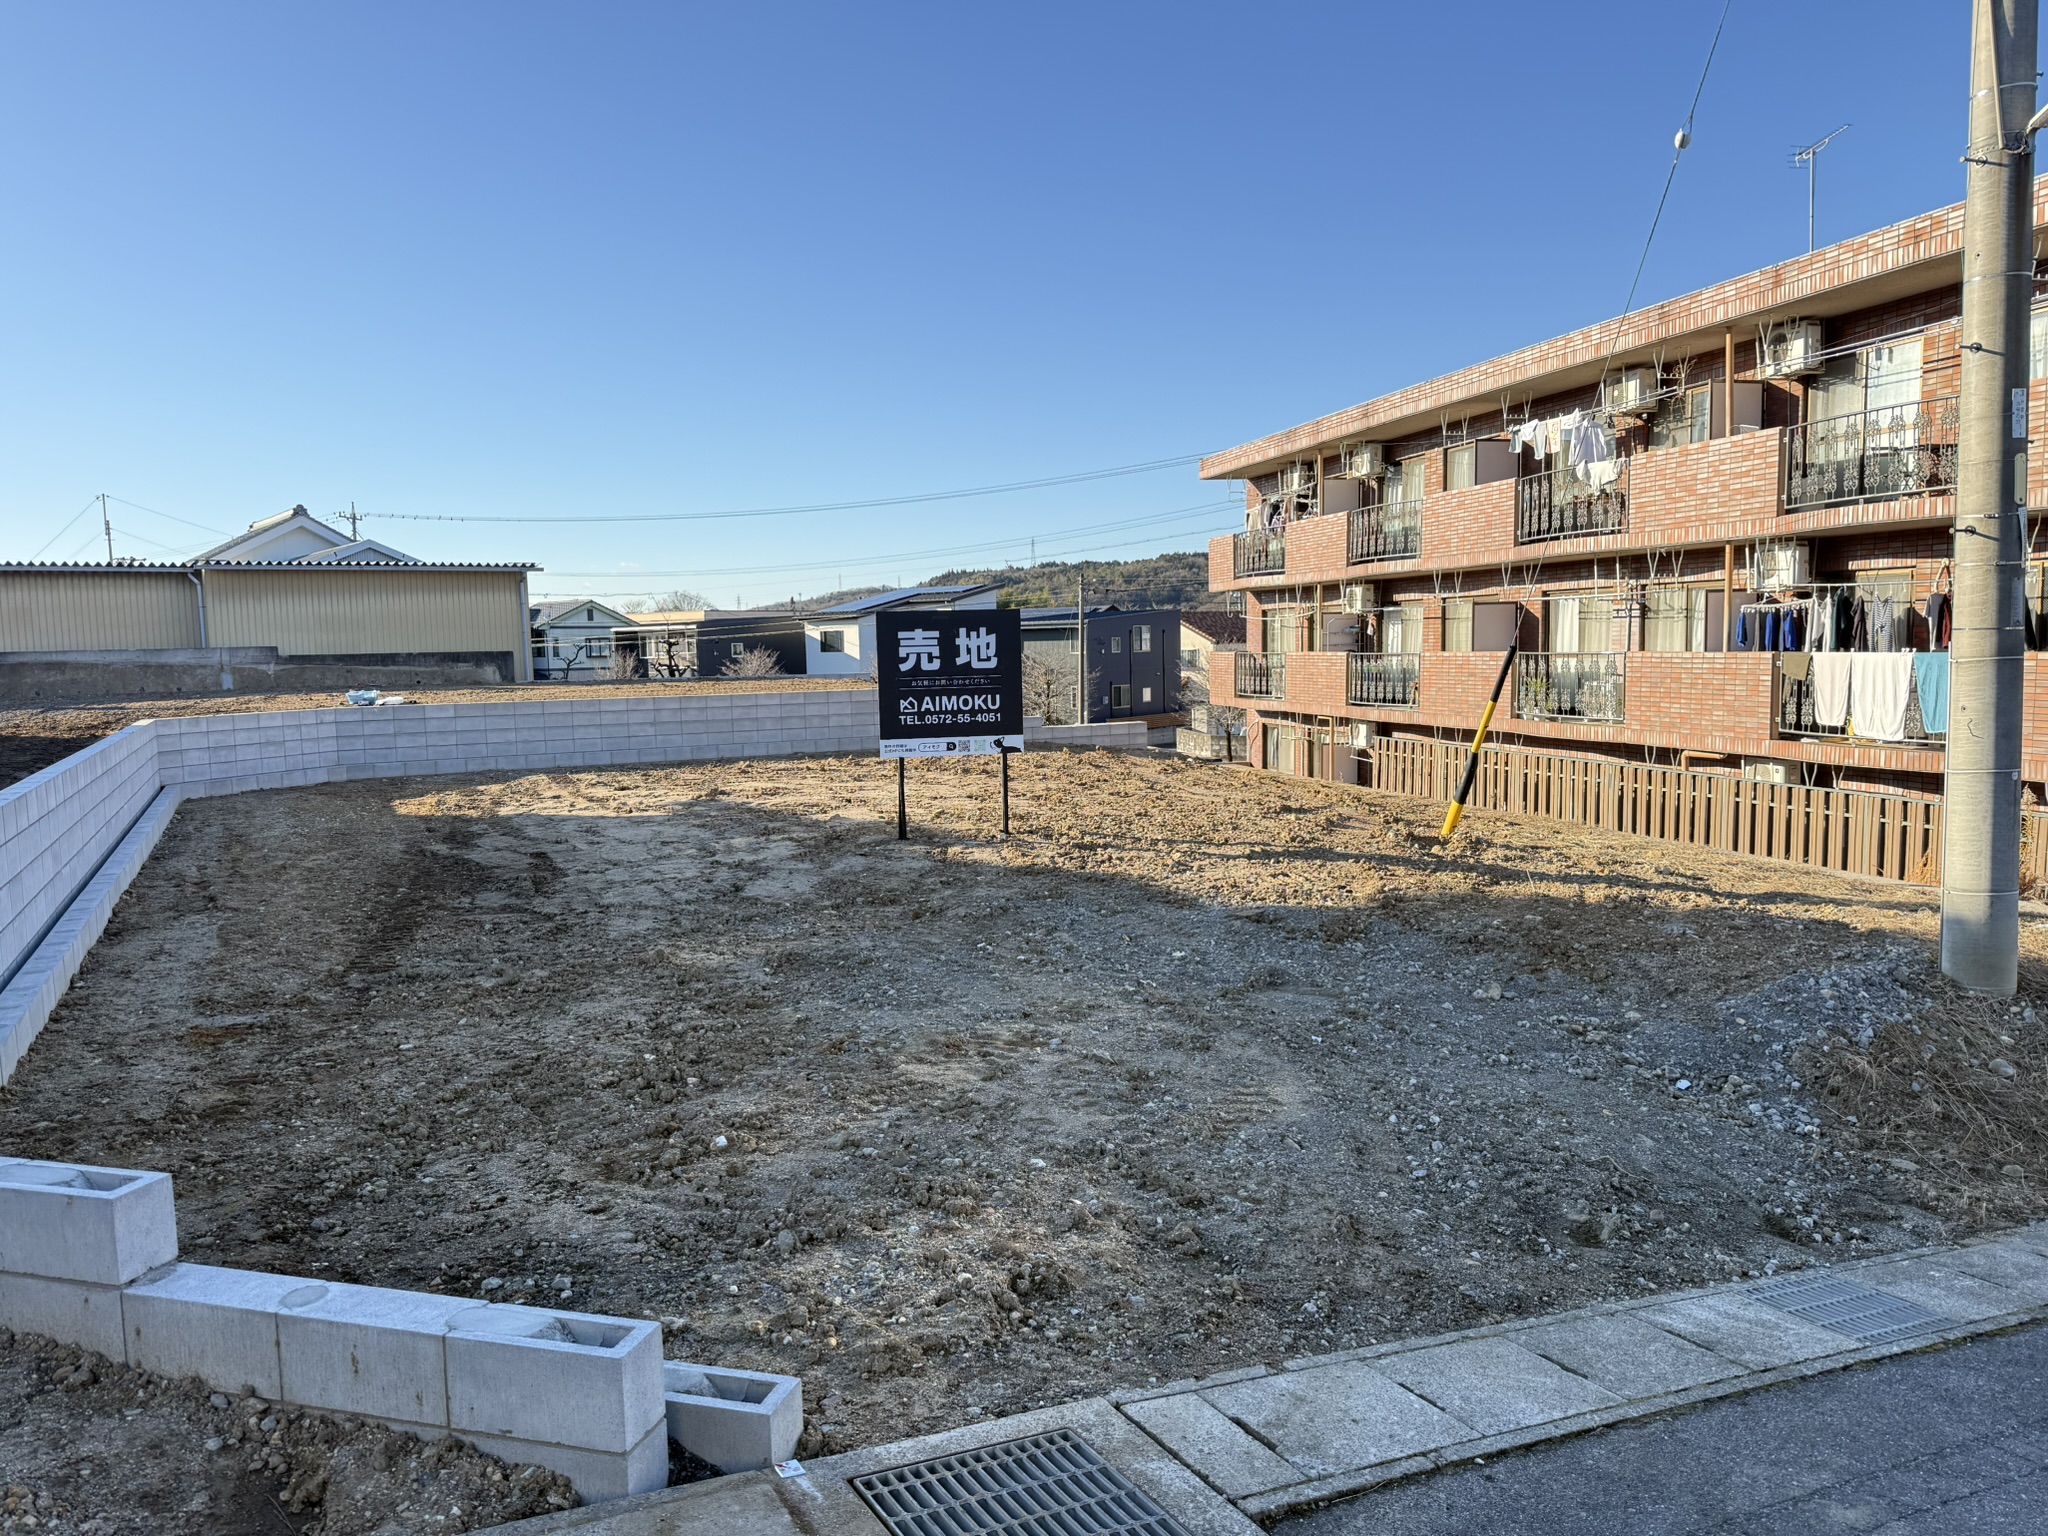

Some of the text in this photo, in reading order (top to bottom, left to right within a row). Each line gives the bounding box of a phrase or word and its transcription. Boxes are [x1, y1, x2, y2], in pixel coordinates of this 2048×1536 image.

[897, 627, 998, 672] 売地
[911, 678, 991, 687] お気軽にお問い合わせください
[920, 694, 1000, 712] AIMOKU
[898, 712, 1001, 725] TEL.0572-55-4051
